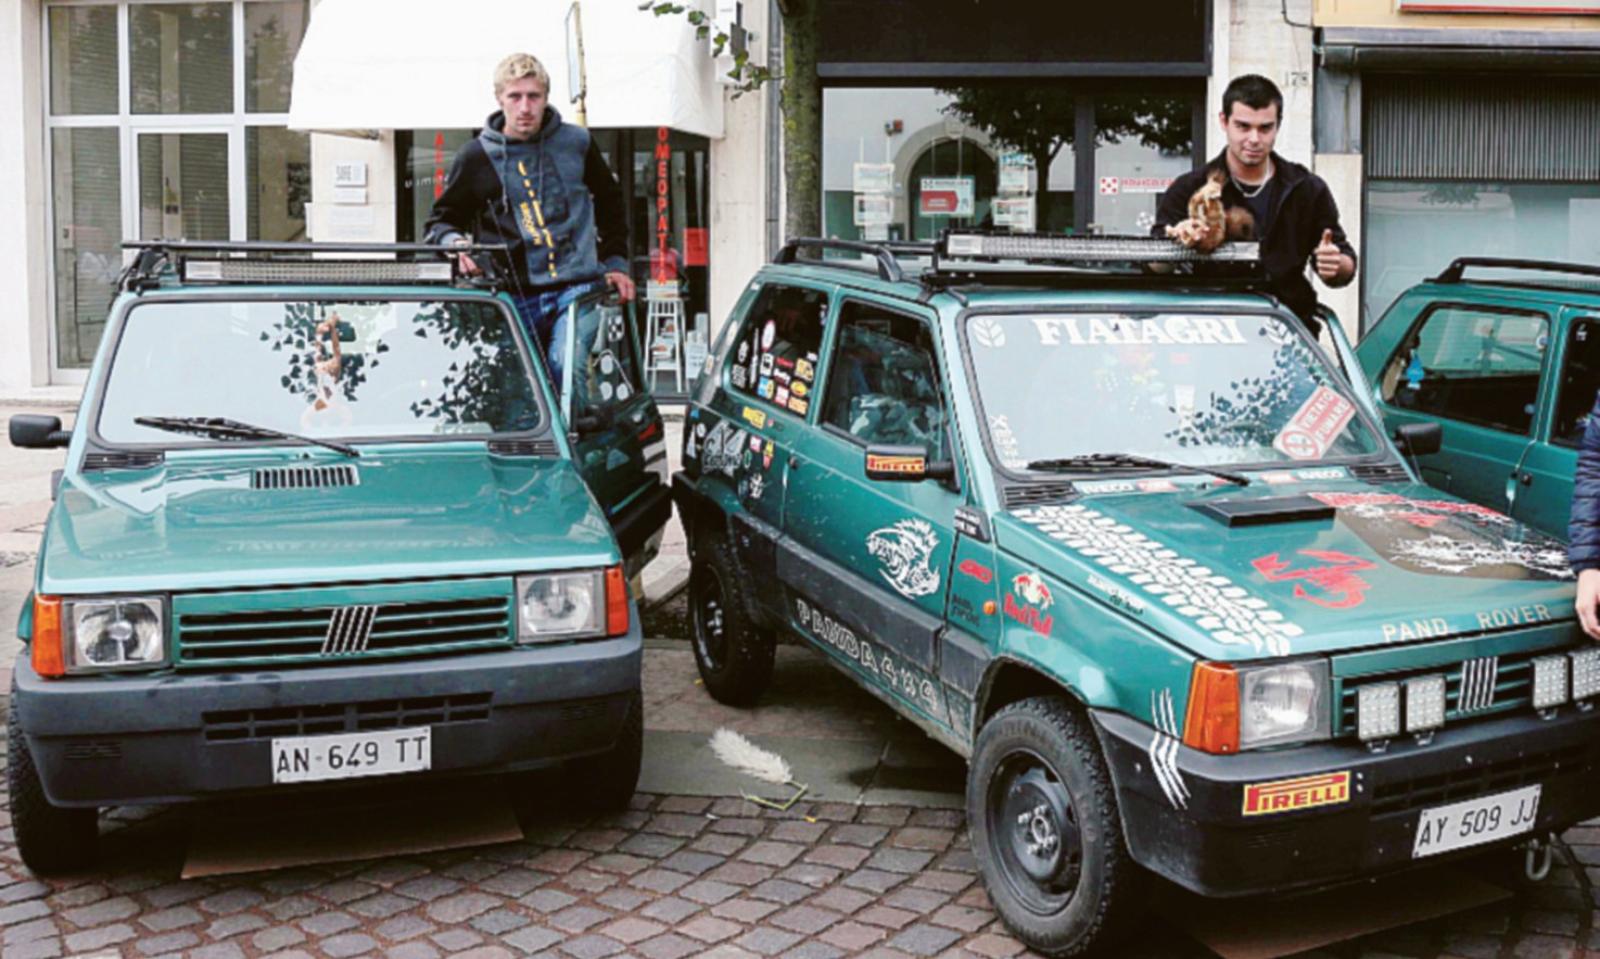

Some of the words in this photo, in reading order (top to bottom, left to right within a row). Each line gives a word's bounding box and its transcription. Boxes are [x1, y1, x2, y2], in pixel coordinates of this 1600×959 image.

[655, 126, 670, 285] OMEOPATIA
[1032, 318, 1246, 345] FIATAGRI
[1476, 604, 1551, 629] ROVER
[395, 736, 427, 763] TT
[1246, 773, 1347, 812] PIRELLI
[1418, 817, 1448, 847] AY
[1460, 803, 1501, 838] 509
[1511, 794, 1537, 826] JJ
